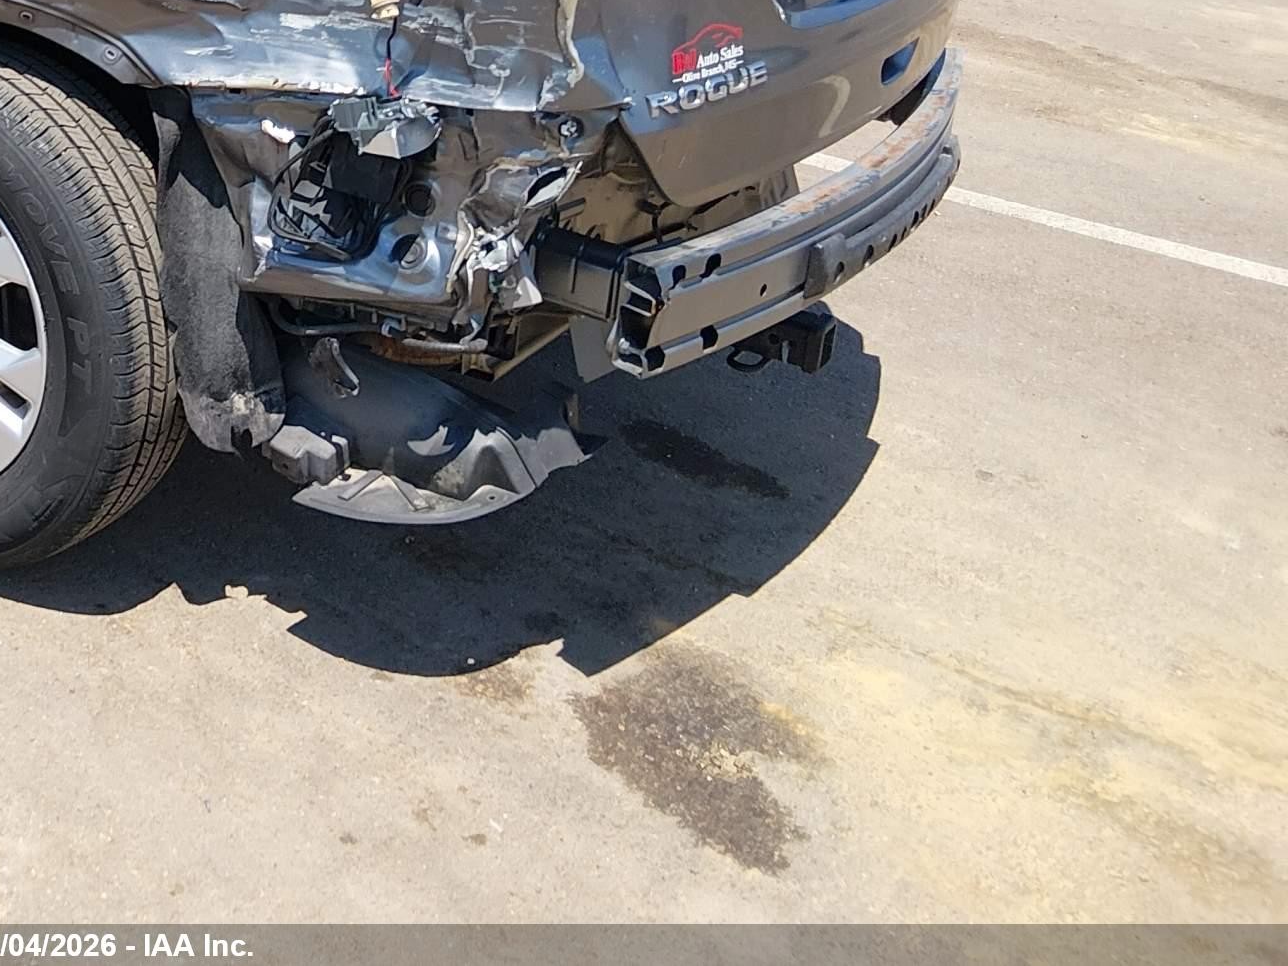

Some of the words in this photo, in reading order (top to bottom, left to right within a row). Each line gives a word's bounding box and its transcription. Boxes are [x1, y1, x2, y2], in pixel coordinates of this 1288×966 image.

[696, 51, 719, 69] Auto
[720, 42, 744, 61] Sales
[645, 61, 768, 118] ROGUE
